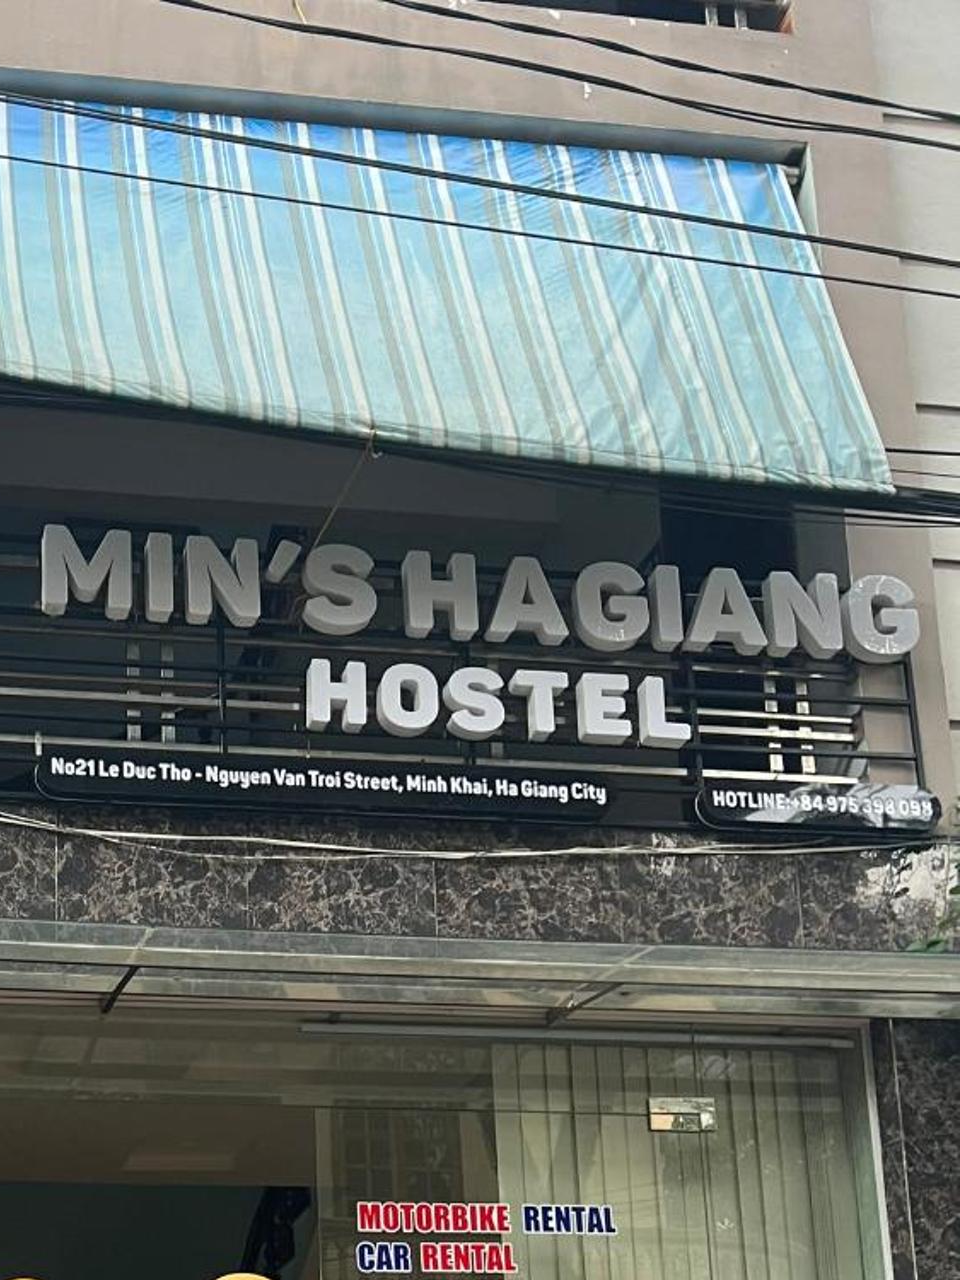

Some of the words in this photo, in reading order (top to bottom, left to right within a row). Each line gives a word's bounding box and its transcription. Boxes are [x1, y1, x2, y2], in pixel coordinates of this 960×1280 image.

[41, 523, 378, 636] MIN'S
[306, 657, 692, 749] HOSTEL
[51, 757, 95, 776] No21
[98, 760, 120, 778] Le
[123, 761, 157, 780] Duc
[158, 762, 192, 781] Tho
[205, 765, 271, 789] Nguyen
[273, 768, 306, 787] Van
[307, 770, 341, 788] Troi
[343, 771, 404, 793] Street,
[406, 774, 448, 793] Minh
[450, 776, 493, 798] Khai,
[495, 778, 519, 796] Ha
[520, 780, 569, 804] Giang
[570, 782, 608, 806] City
[356, 1202, 511, 1234] MOTORBIKE
[522, 1204, 617, 1234] RENTAL
[356, 1242, 413, 1273] CAR
[419, 1243, 517, 1273] RENTAL
